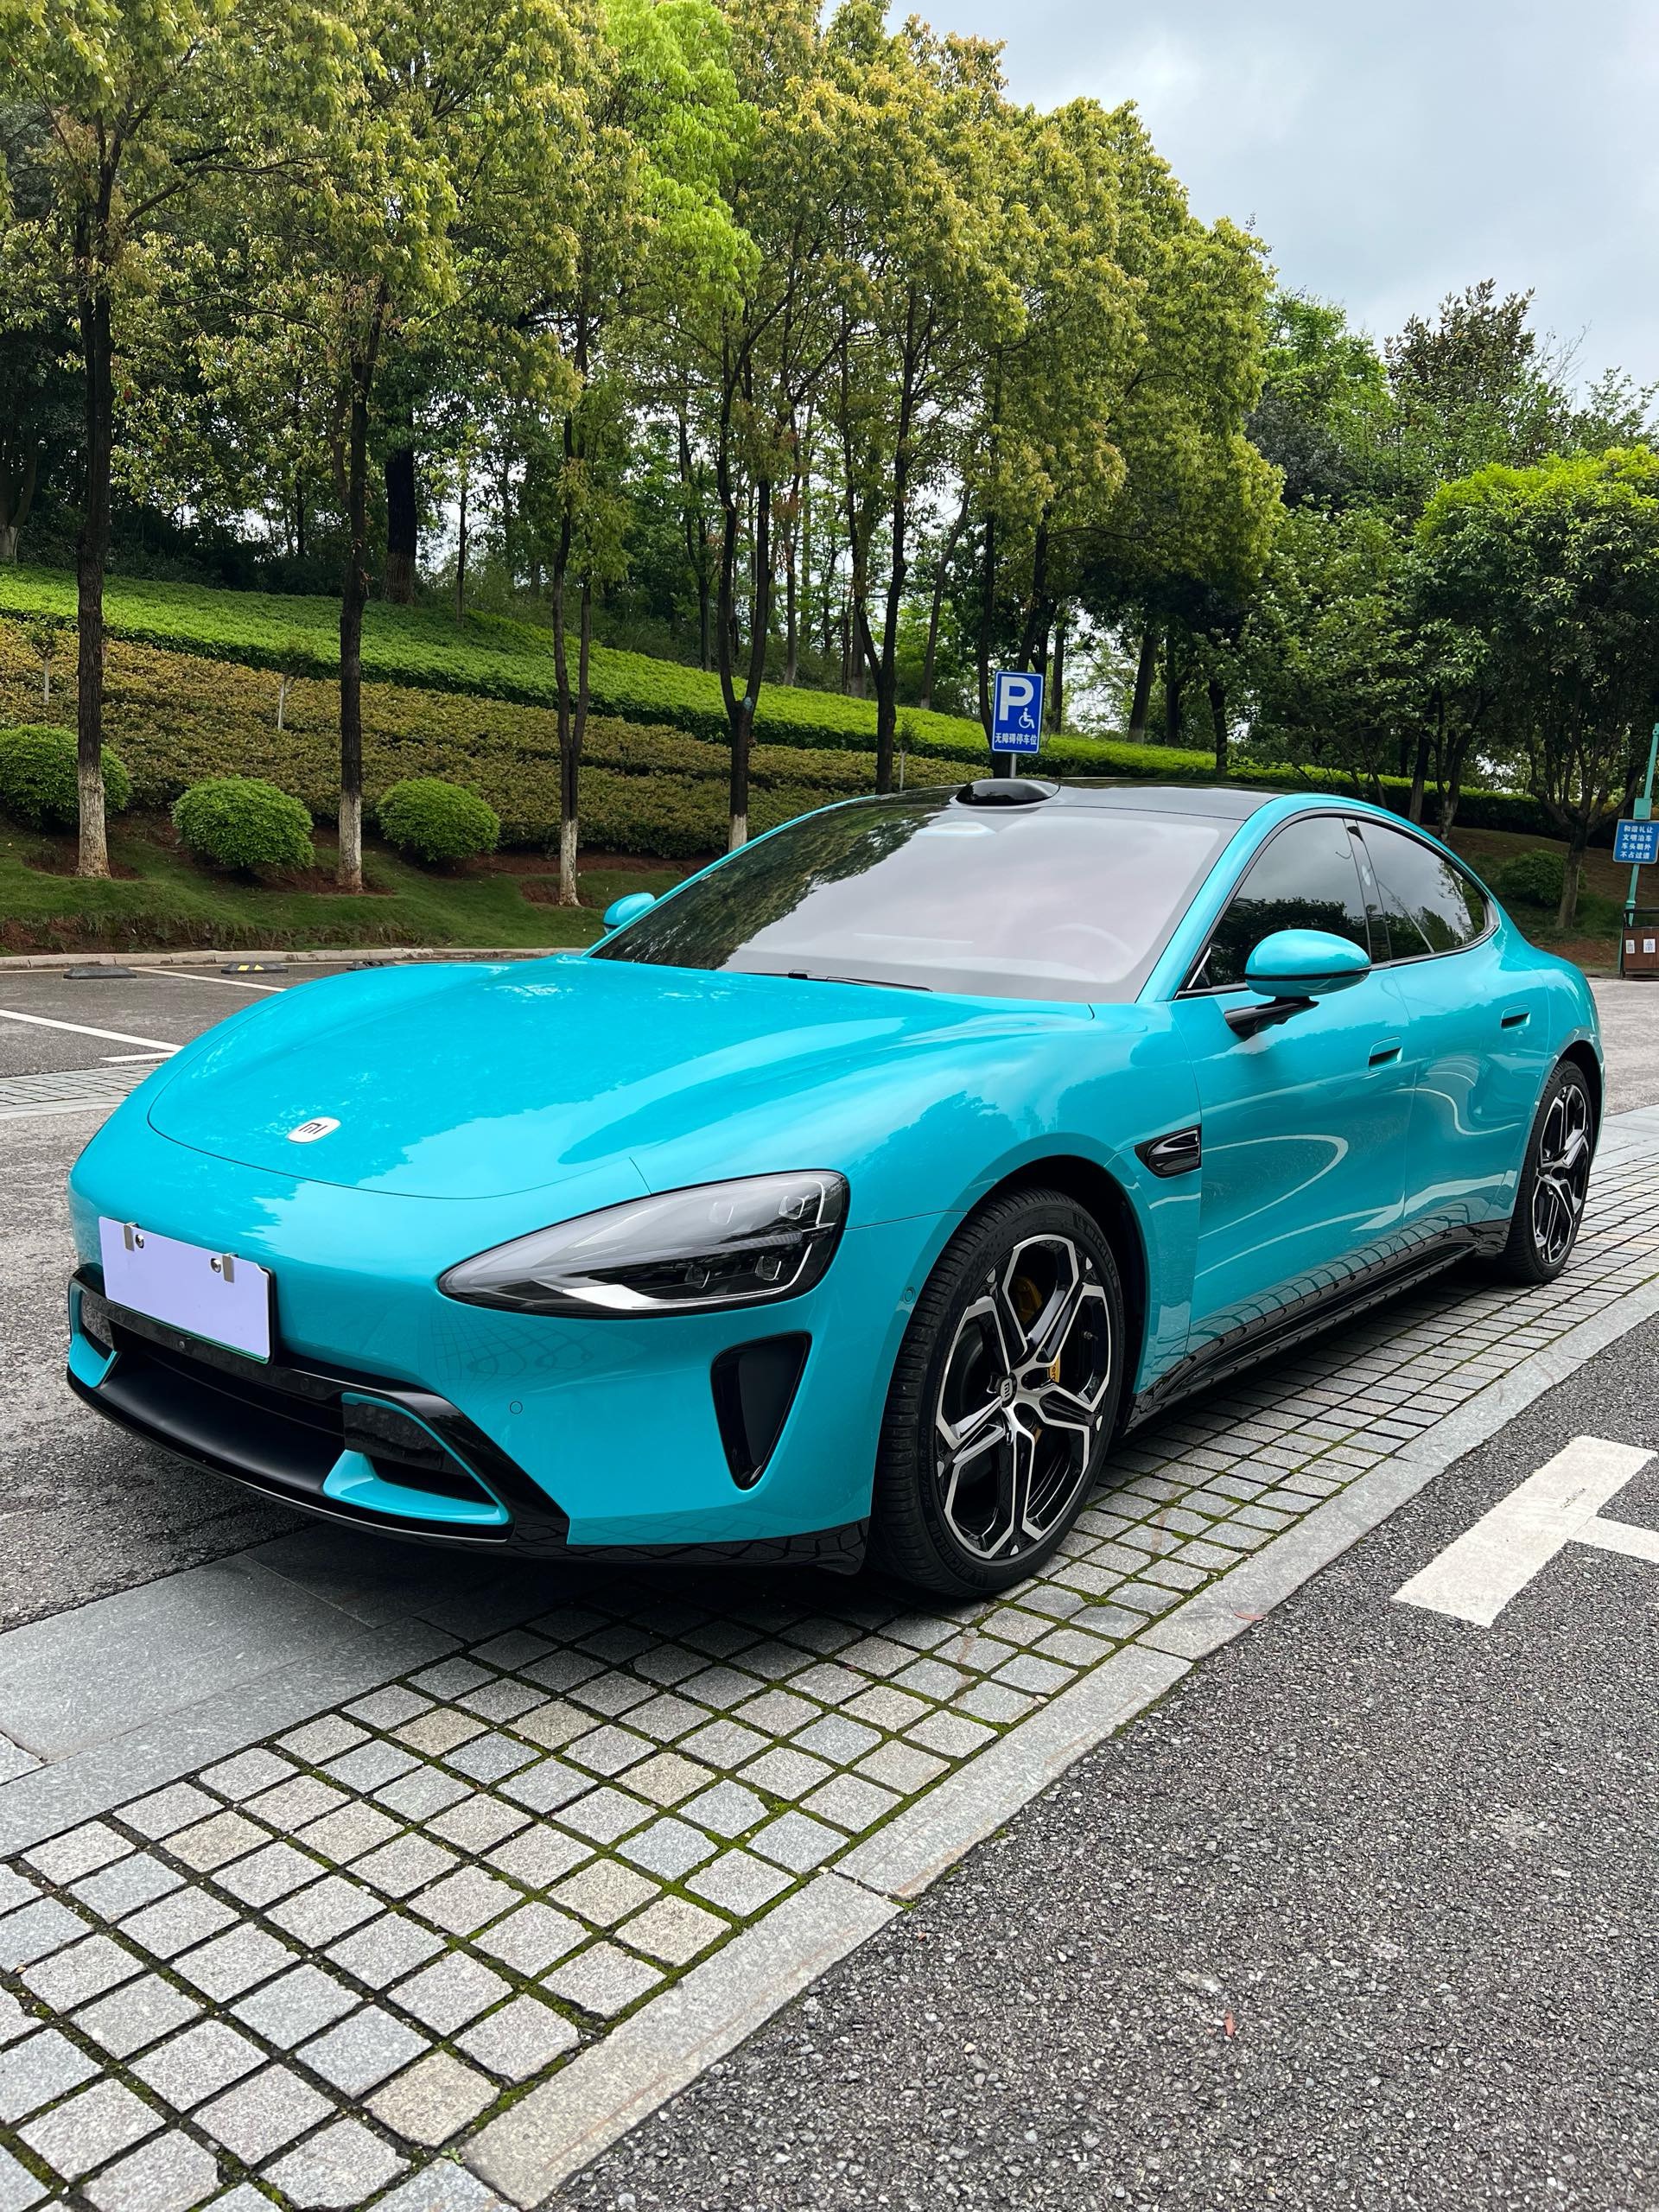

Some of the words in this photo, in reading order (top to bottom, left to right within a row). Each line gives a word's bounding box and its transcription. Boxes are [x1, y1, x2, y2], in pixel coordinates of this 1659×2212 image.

[999, 676, 1034, 721] P
[995, 733, 1038, 745] 无障碍停车位
[1624, 825, 1653, 834] 和谐礼让
